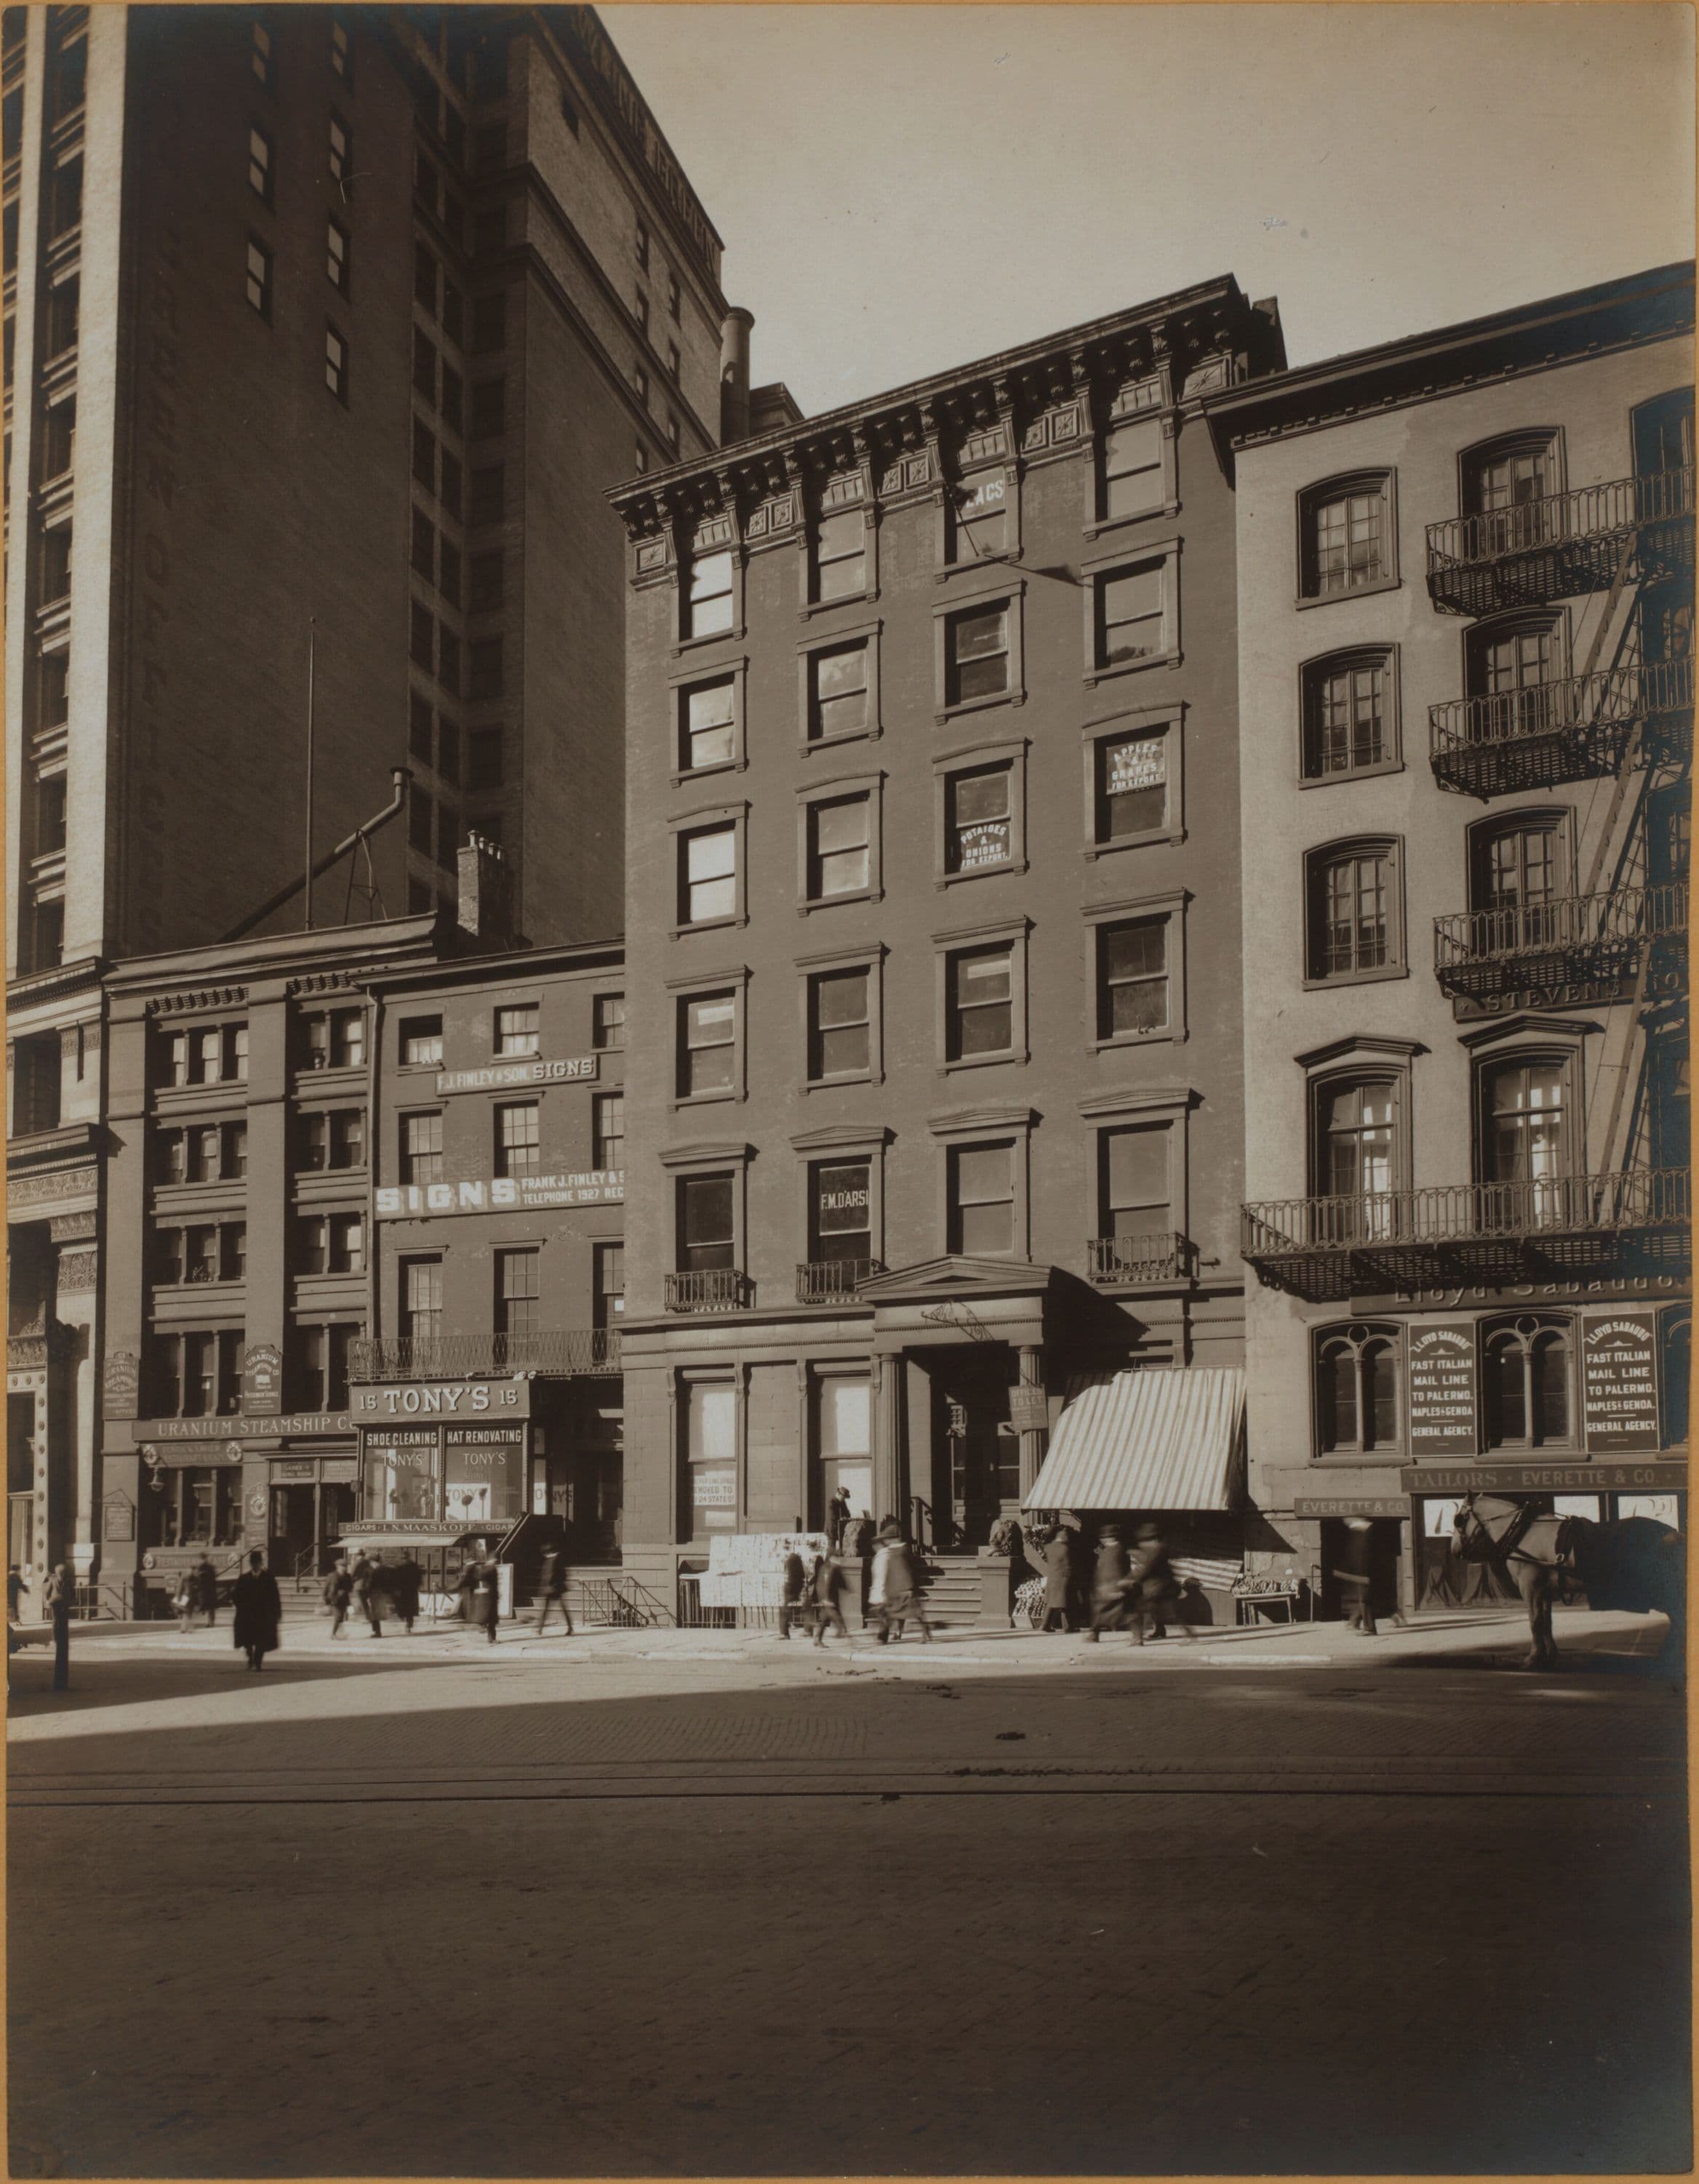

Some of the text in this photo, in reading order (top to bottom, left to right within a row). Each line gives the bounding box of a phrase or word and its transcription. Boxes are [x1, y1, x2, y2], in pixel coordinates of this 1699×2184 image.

[1114, 743, 1158, 762] APPLES
[1112, 762, 1157, 780] GRAPES
[960, 824, 1007, 844] POTATOES
[966, 843, 1002, 859] ONIONS
[457, 1070, 494, 1087] FINLEY
[532, 1059, 594, 1080] SIGNS
[375, 1178, 518, 1213] SIGNS
[522, 1175, 556, 1189] FRANK
[568, 1171, 605, 1187] FINLEY
[608, 1170, 617, 1183] &
[522, 1190, 574, 1204] TELEPHONE
[578, 1188, 600, 1201] 1927
[1586, 1321, 1651, 1345] LLOYD SABAUDO
[1412, 1330, 1471, 1354] LLOYD SABAUDO
[246, 1354, 279, 1367] URANIUM
[1586, 1351, 1651, 1364] FAST ITALIAN
[1412, 1359, 1473, 1370] FAST ITALIAN
[1413, 1374, 1469, 1386] MAIL LINE
[1588, 1367, 1650, 1380] MAIL LINE
[1412, 1391, 1425, 1401] TO
[1588, 1386, 1601, 1397] TO
[359, 1386, 518, 1414] 15 TONY'S 15
[1012, 1396, 1043, 1407] TO LET
[1587, 1401, 1617, 1412] NAPLES
[1412, 1406, 1441, 1417] NAPLES
[158, 1421, 231, 1436] URANIUM
[240, 1418, 331, 1434] STEAMSHIP
[1412, 1426, 1442, 1437] GENERAL
[1587, 1421, 1623, 1432] GENERAL
[367, 1431, 437, 1447] SHOE CLEANING
[447, 1429, 522, 1444] HAT RENOVATING
[382, 1453, 422, 1466] TONY'S
[462, 1452, 506, 1465] TONY'S
[1411, 1469, 1497, 1487] TAILORS
[1521, 1469, 1607, 1486] EVERETTE
[1615, 1469, 1627, 1485] &
[699, 1485, 733, 1494] MOVED TO
[1302, 1501, 1372, 1514] EVERETTE
[1374, 1501, 1382, 1513] &
[345, 1523, 377, 1532] CIGARS
[485, 1523, 514, 1532] CIGAR
